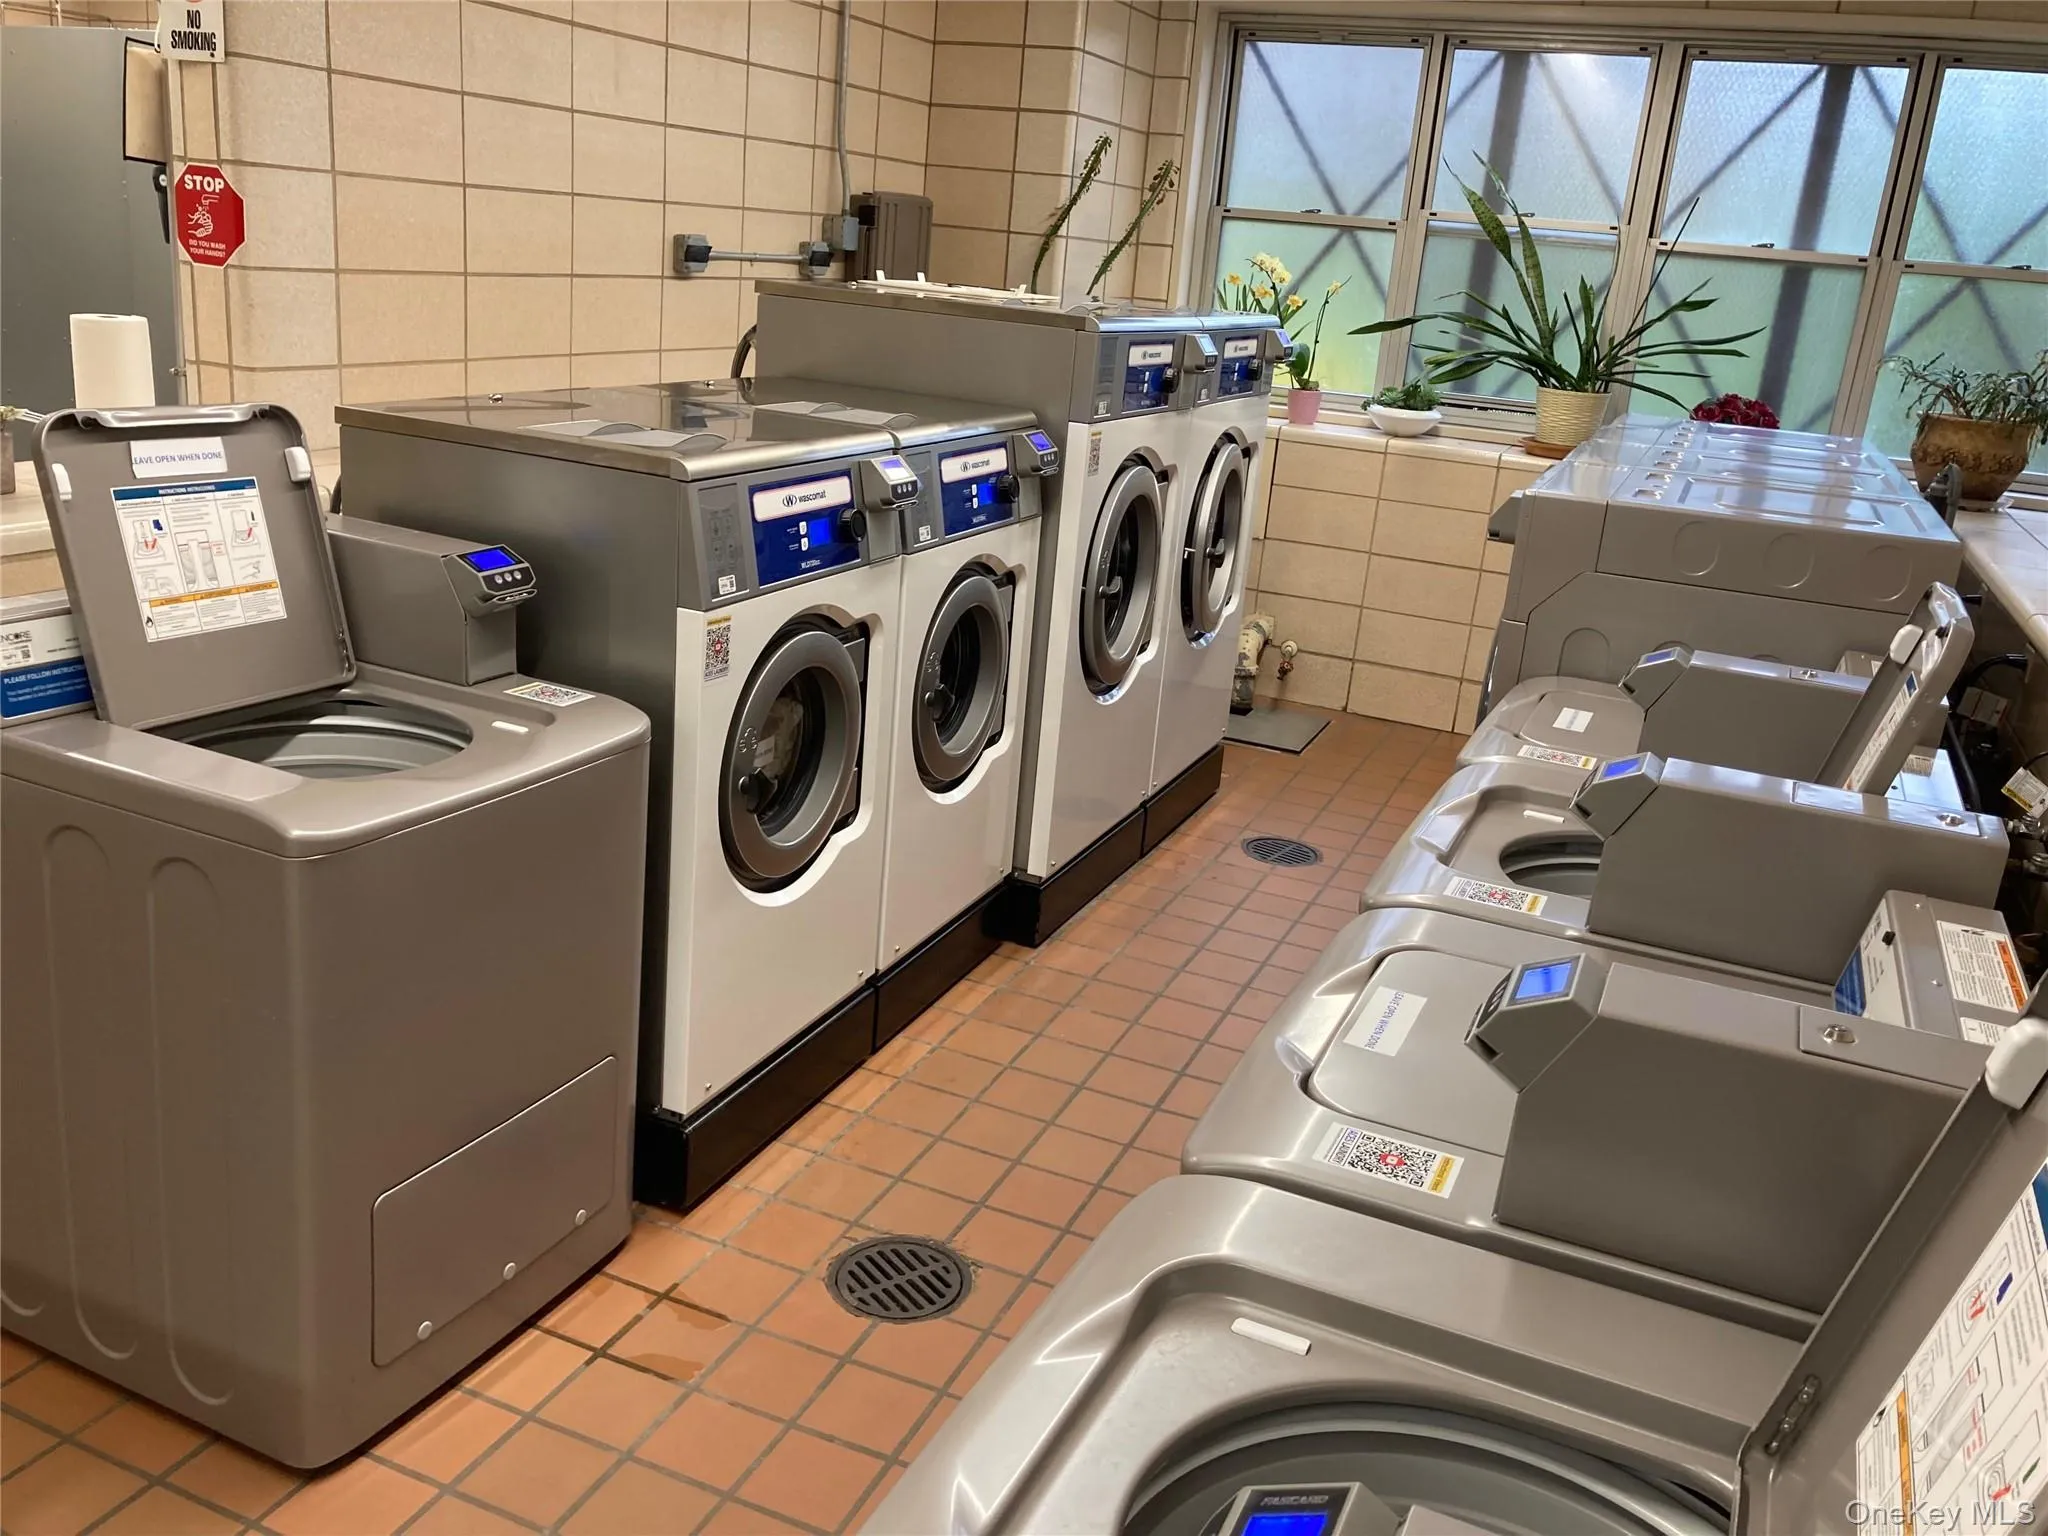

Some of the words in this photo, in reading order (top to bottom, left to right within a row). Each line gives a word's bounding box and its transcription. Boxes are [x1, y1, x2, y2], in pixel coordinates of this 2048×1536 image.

[186, 9, 201, 29] NO
[170, 30, 217, 51] SMOKING
[184, 174, 224, 193] STOP
[190, 247, 205, 255] YOUR
[204, 249, 226, 258] HANDS?
[210, 242, 226, 250] WASH
[155, 455, 176, 463] OPEN
[177, 453, 201, 461] WHEN
[201, 452, 223, 460] DONE
[798, 490, 826, 503] wascomat
[4, 675, 27, 685] PLEASE
[27, 670, 52, 680] FOLLOW
[1331, 1140, 1352, 1164] LAUNDRY
